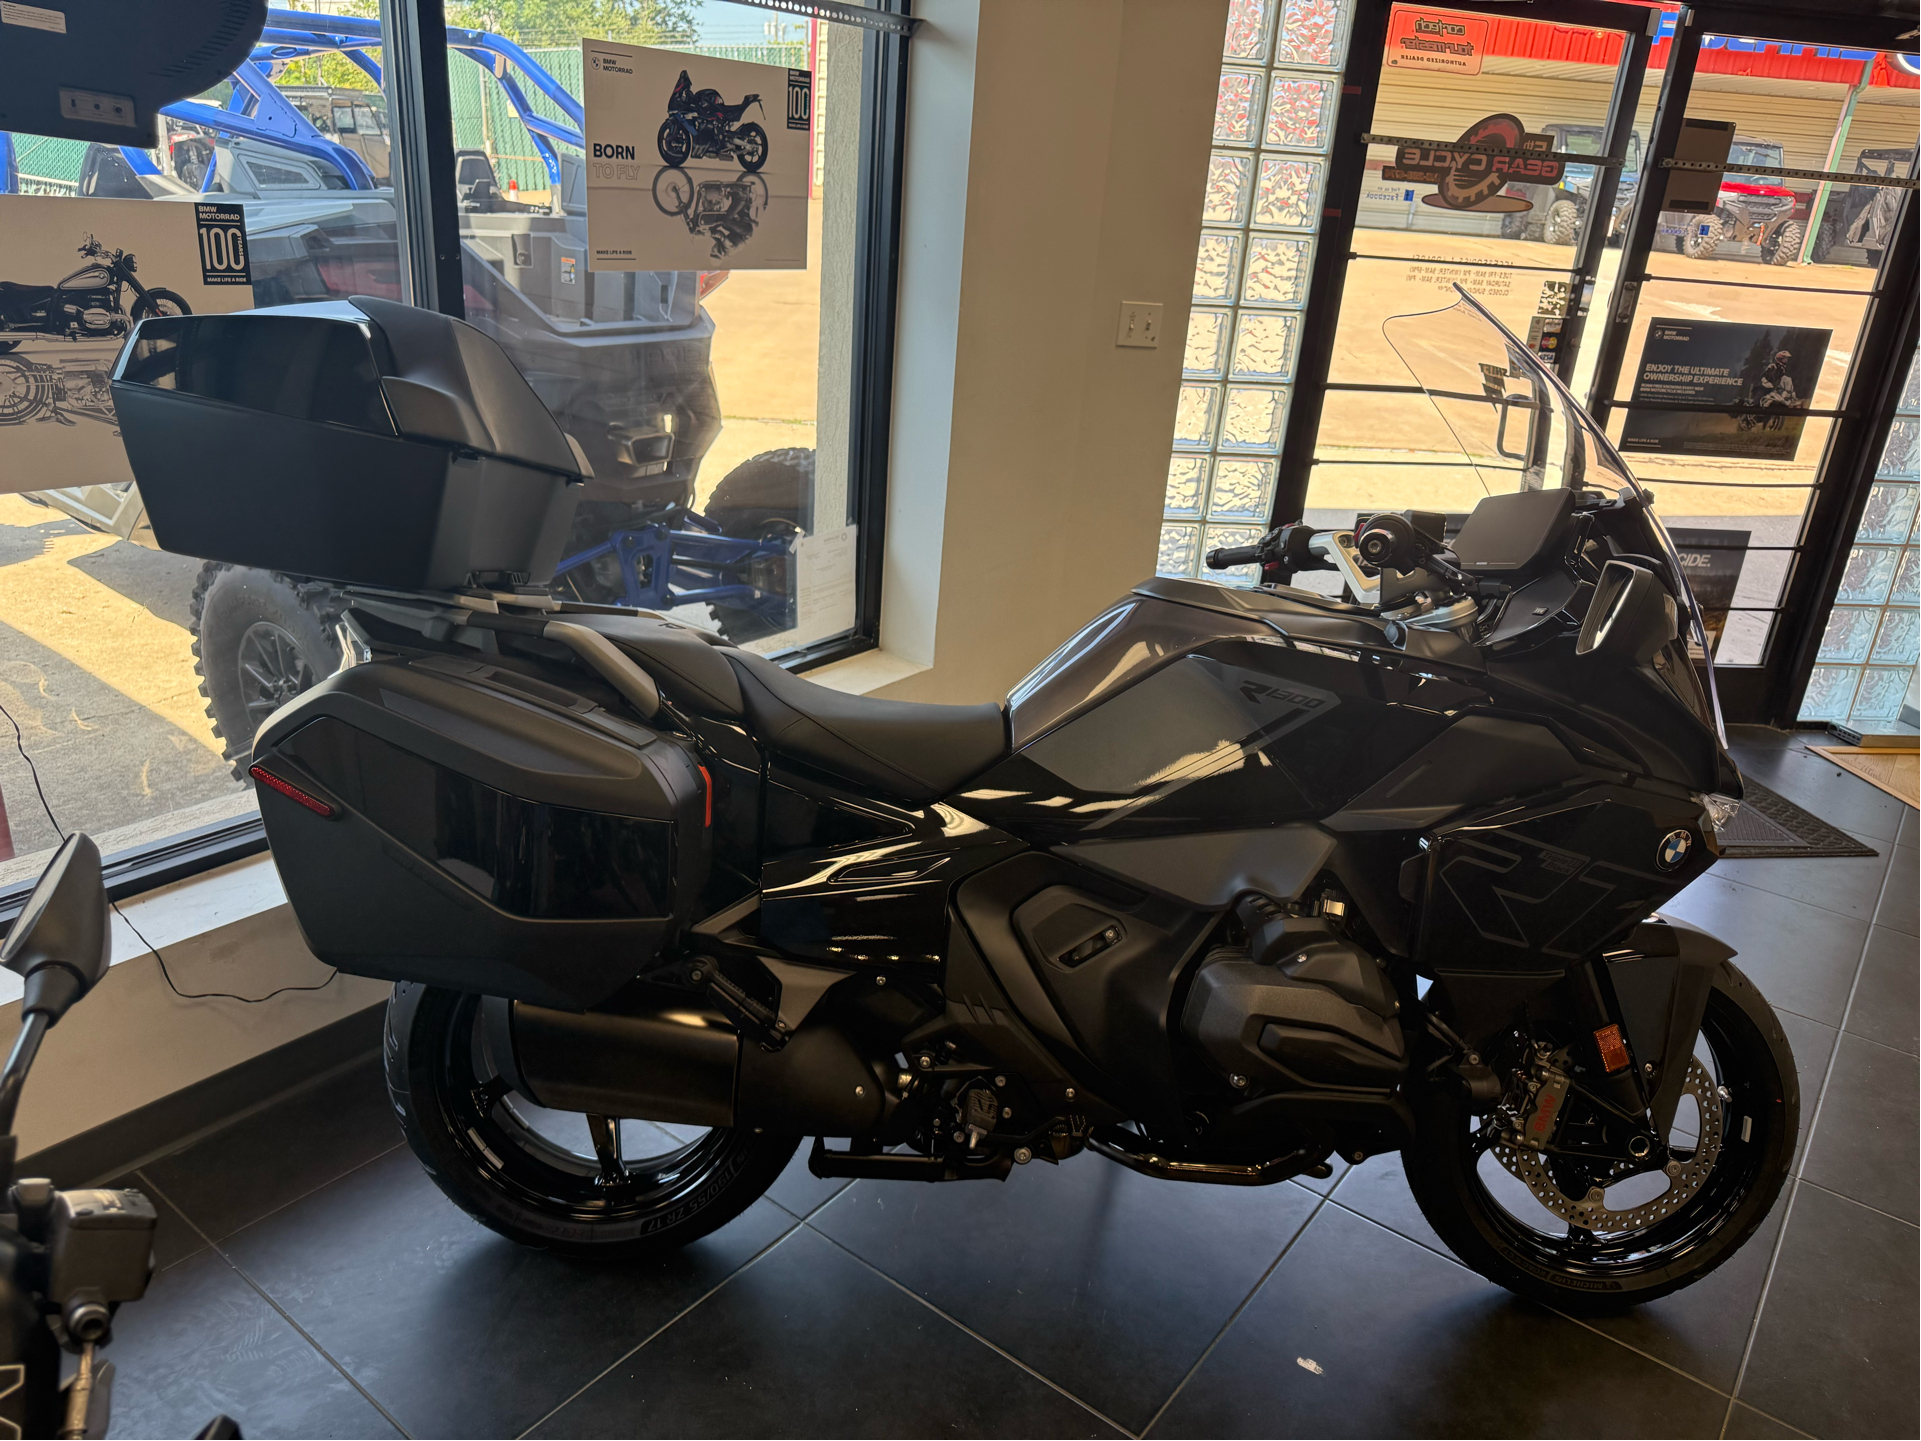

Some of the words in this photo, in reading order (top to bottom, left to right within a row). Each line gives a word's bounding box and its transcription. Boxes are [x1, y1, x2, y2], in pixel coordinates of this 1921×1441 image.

[602, 65, 634, 74] MOTORRAD
[788, 86, 810, 119] 100
[593, 143, 635, 161] BORN
[593, 163, 614, 179] TO
[617, 164, 640, 181] FLY
[199, 227, 245, 270] 100
[1645, 363, 1673, 373] ENJOY
[1673, 366, 1690, 374] THE
[1690, 366, 1730, 376] ULTIMATE
[1643, 372, 1693, 383] OWNERSHIP
[1693, 375, 1743, 386] EXPERIENCE
[1669, 831, 1692, 847] BMW
[1543, 851, 1568, 864] Triple
[1545, 861, 1571, 874] Black
[1534, 1093, 1556, 1132] BMW
[689, 1170, 732, 1211] 190/55
[666, 1208, 685, 1224] ZR
[647, 1217, 663, 1232] 17
[1554, 1274, 1604, 1290] MICHELIN
